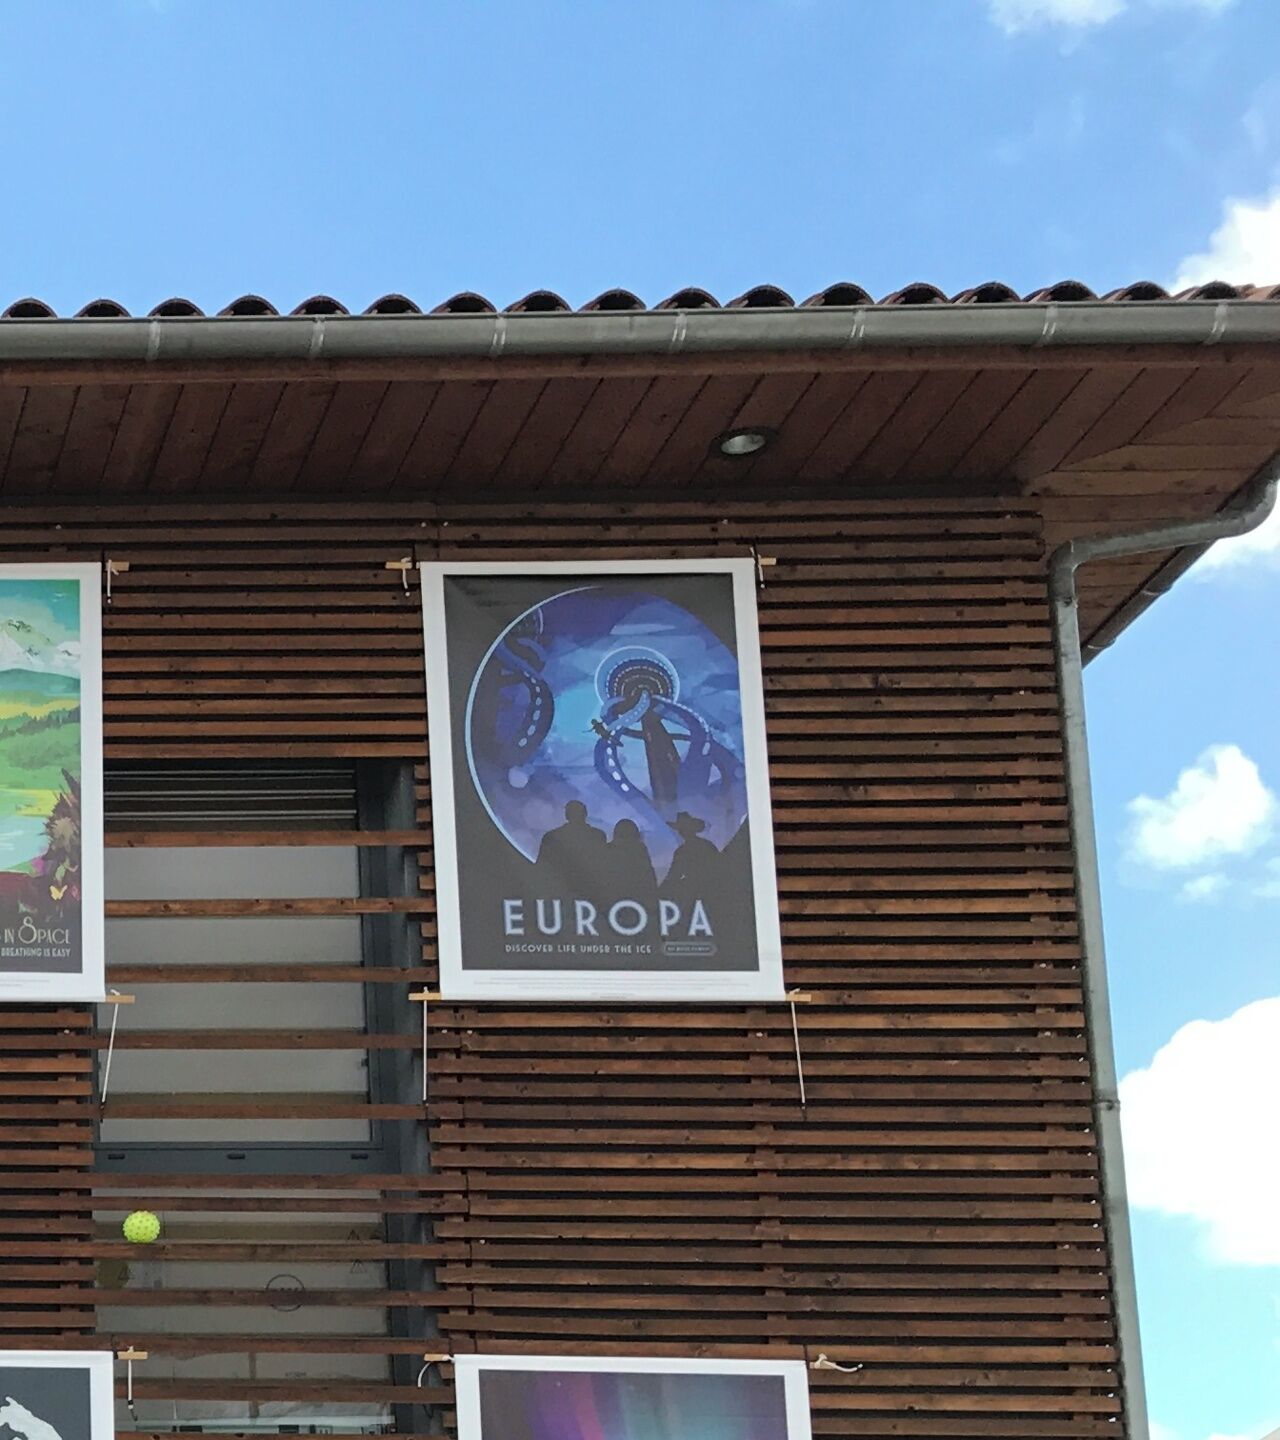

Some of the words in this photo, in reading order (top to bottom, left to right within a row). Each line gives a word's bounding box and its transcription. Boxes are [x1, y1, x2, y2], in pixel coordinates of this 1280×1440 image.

[503, 899, 713, 936] EUROPA
[44, 948, 50, 957] IS
[52, 949, 71, 957] EASY
[505, 944, 553, 953] DISCOVER
[558, 945, 576, 953] LIFE
[580, 945, 610, 953] UNDER
[615, 945, 632, 953] THE
[637, 946, 651, 954] ICE
